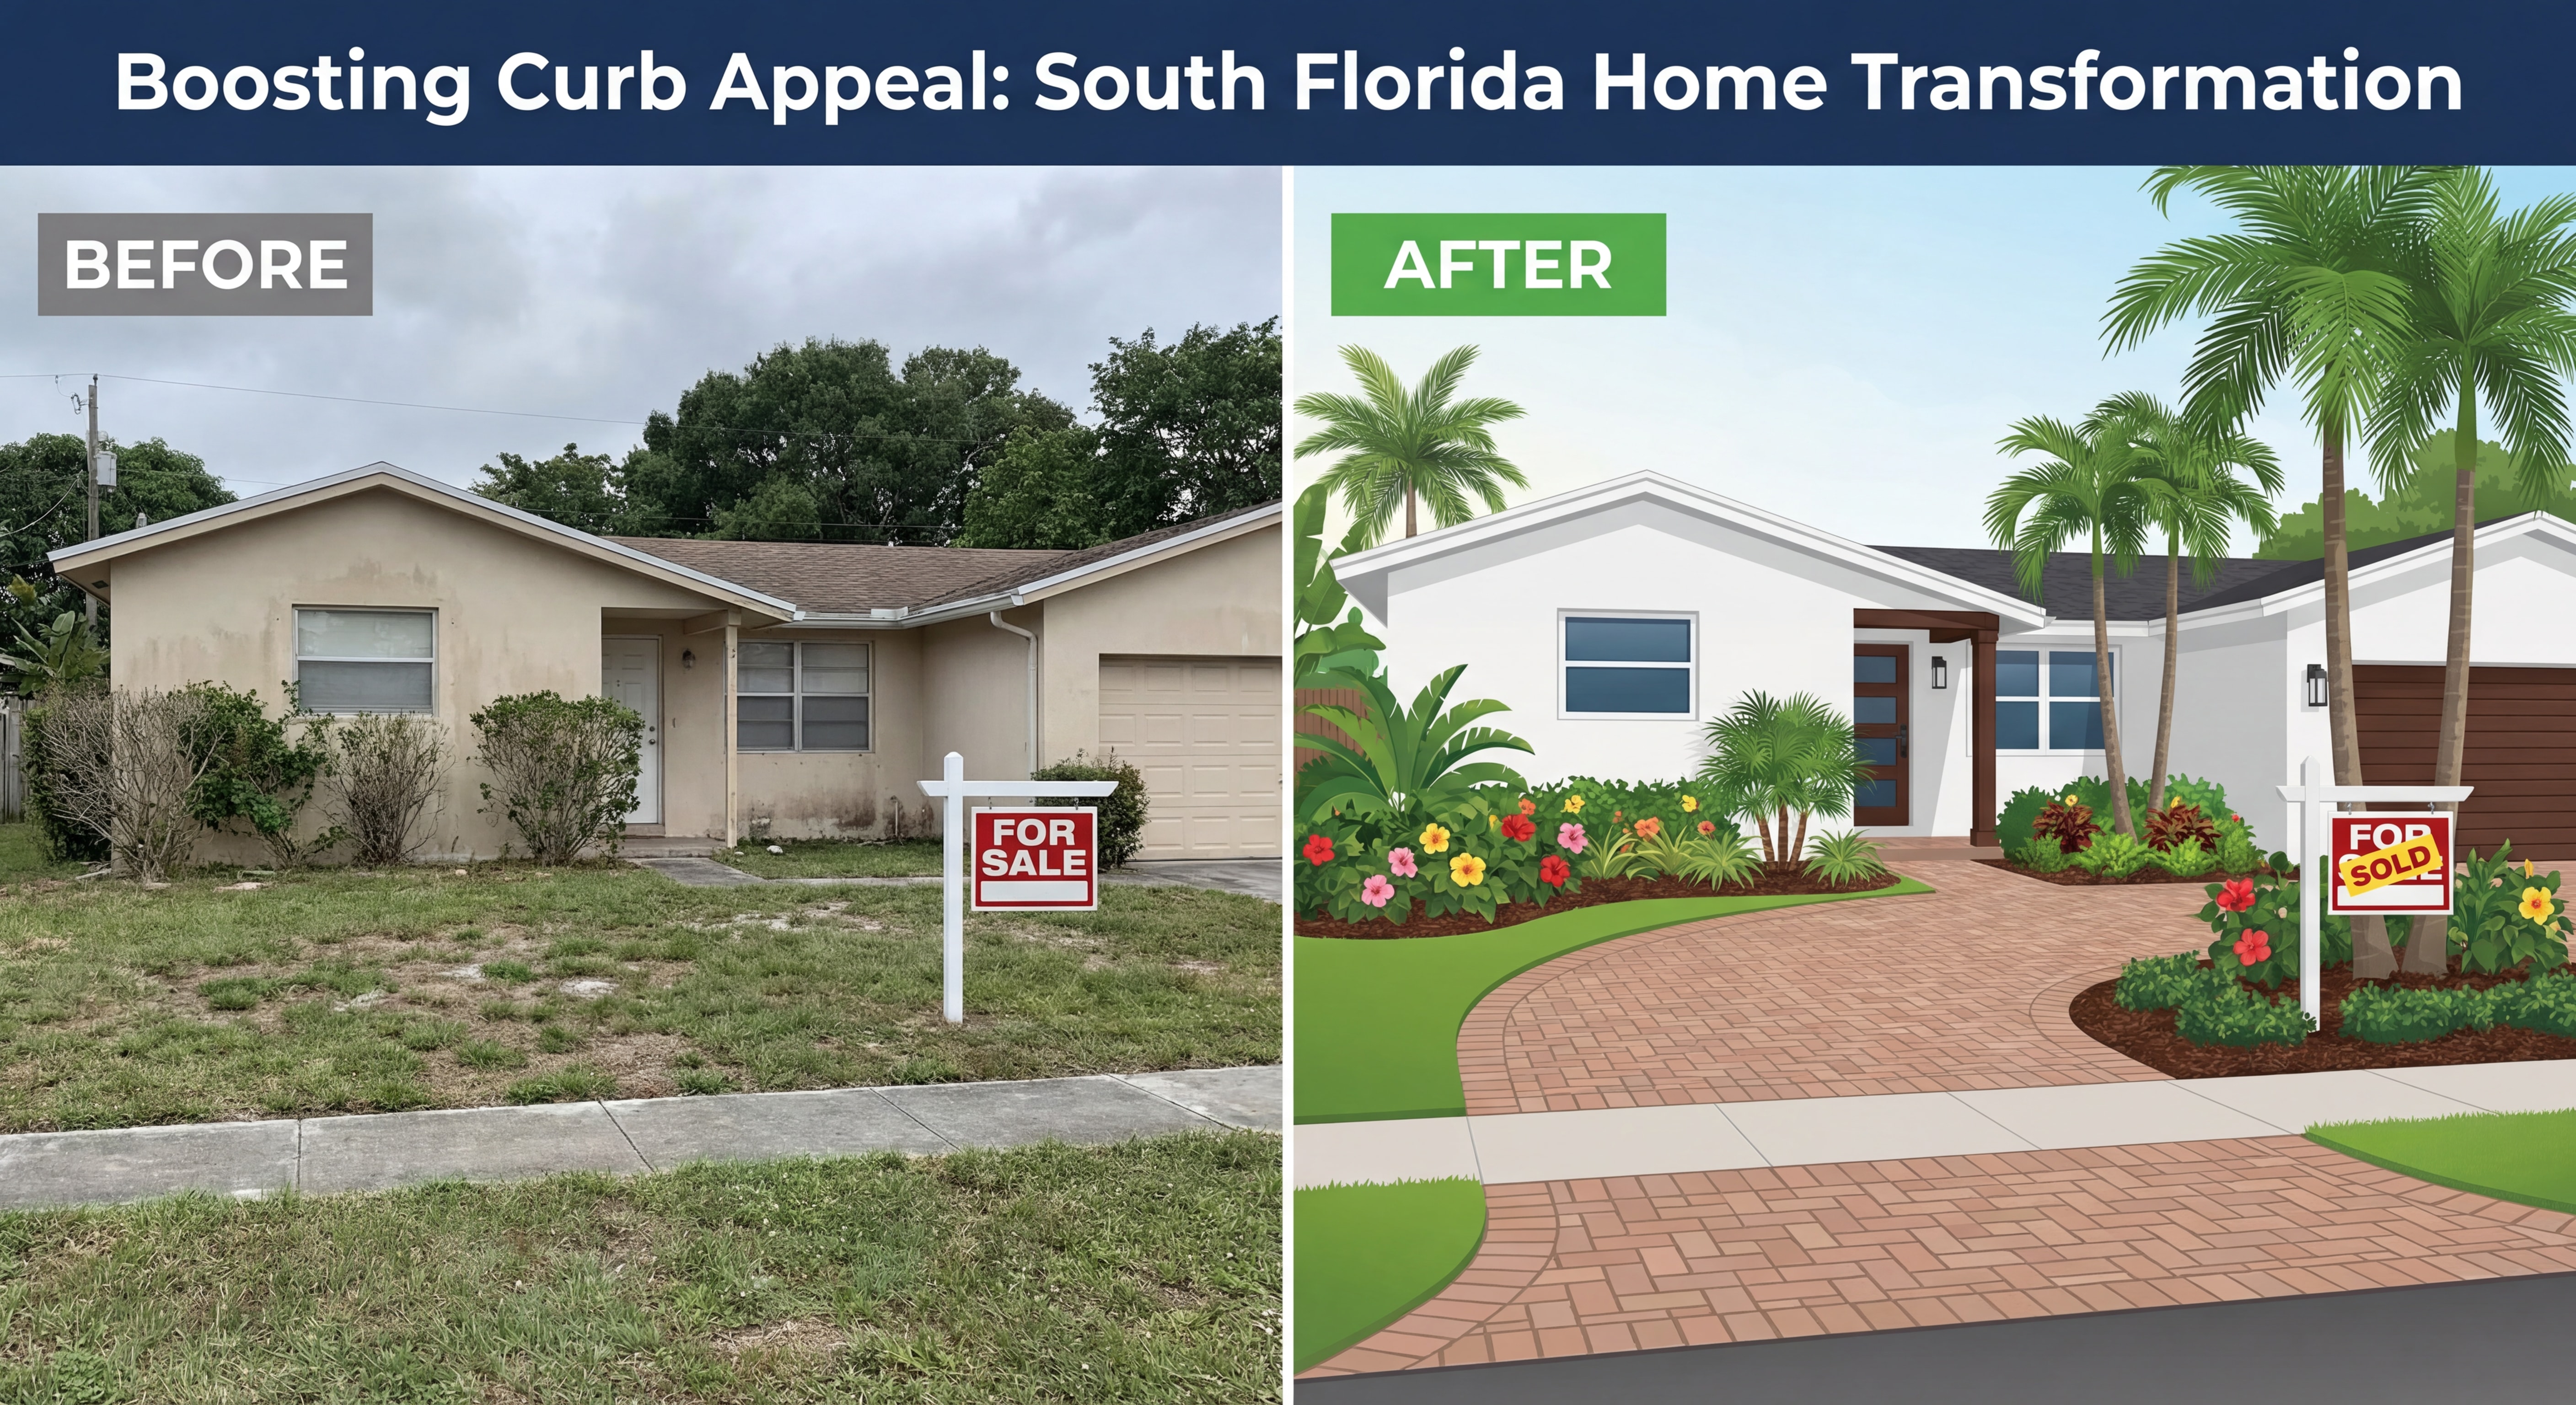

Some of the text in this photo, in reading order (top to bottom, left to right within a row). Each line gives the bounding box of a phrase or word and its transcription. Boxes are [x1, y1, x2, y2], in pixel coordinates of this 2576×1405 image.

[993, 818, 1075, 846] FOR
[982, 849, 1087, 876] SALE
[2351, 846, 2431, 886] SOLD
